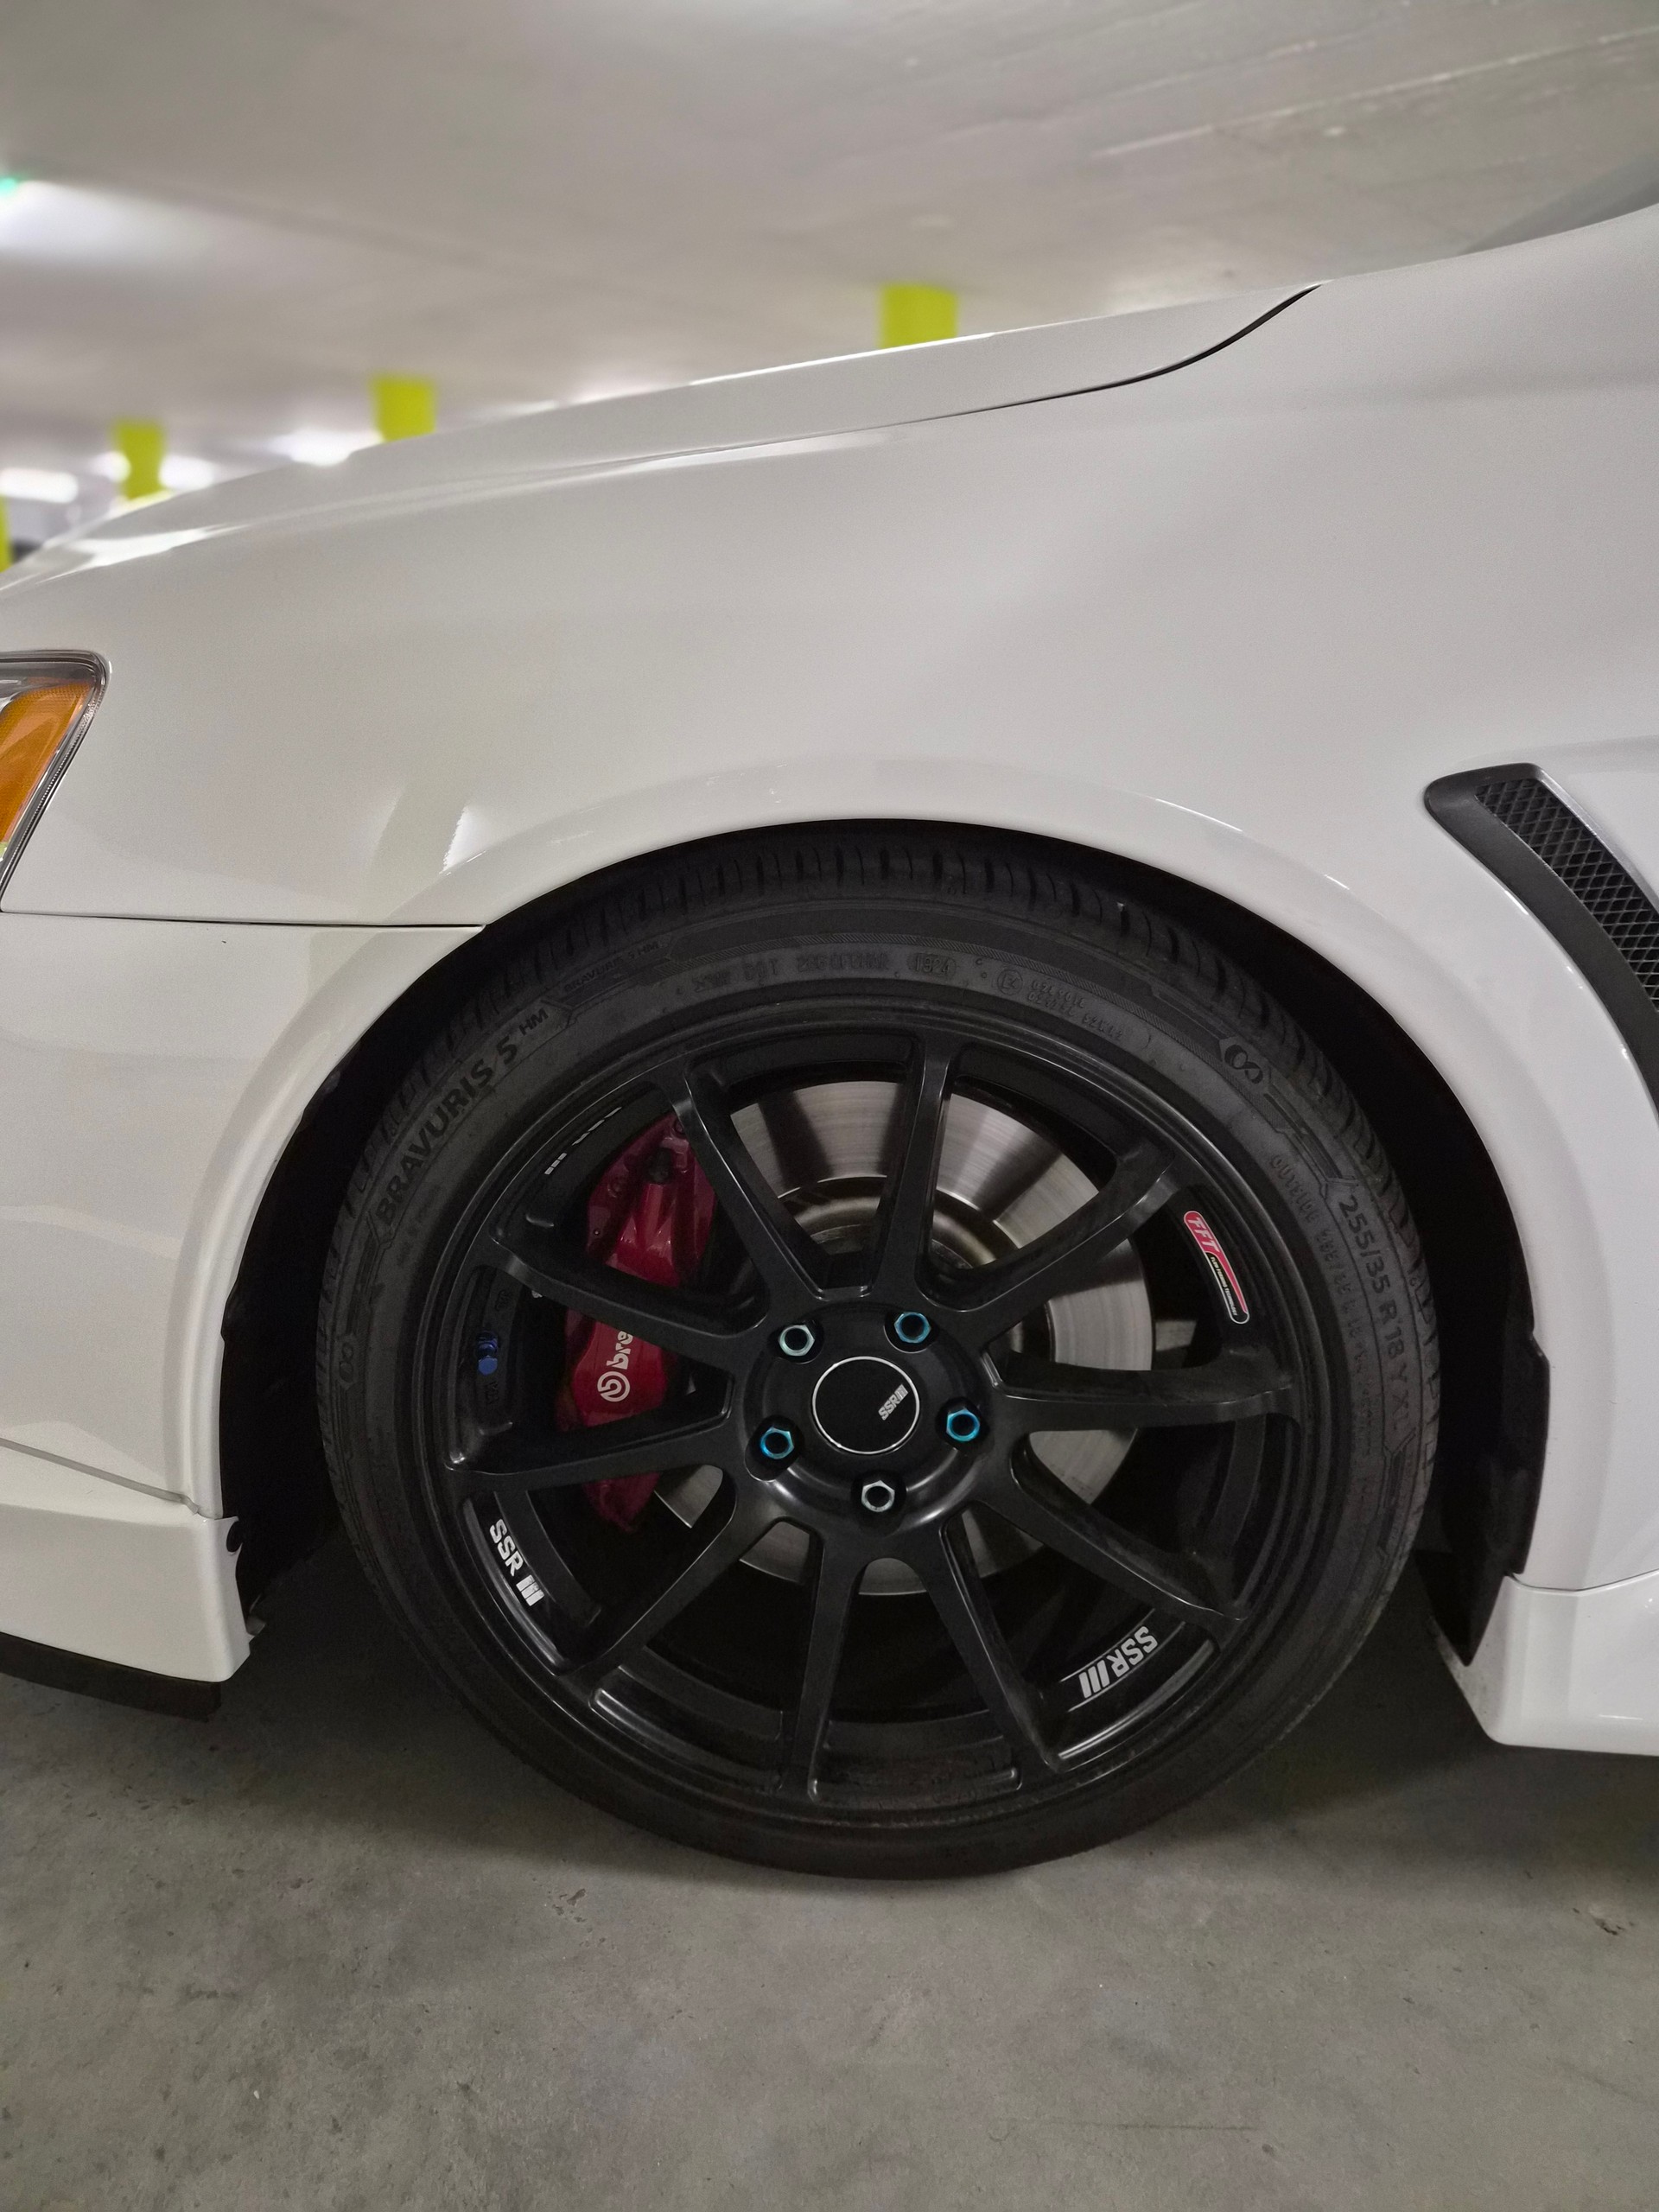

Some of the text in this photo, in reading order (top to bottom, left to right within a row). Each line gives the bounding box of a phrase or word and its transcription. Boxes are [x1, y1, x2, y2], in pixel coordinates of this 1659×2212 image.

[374, 1007, 549, 1226] BRAVURIS 5 HM
[1187, 1217, 1220, 1253] FFT
[1338, 1195, 1390, 1294] 255/35
[1379, 1297, 1398, 1321] R
[1384, 1329, 1406, 1359] 18
